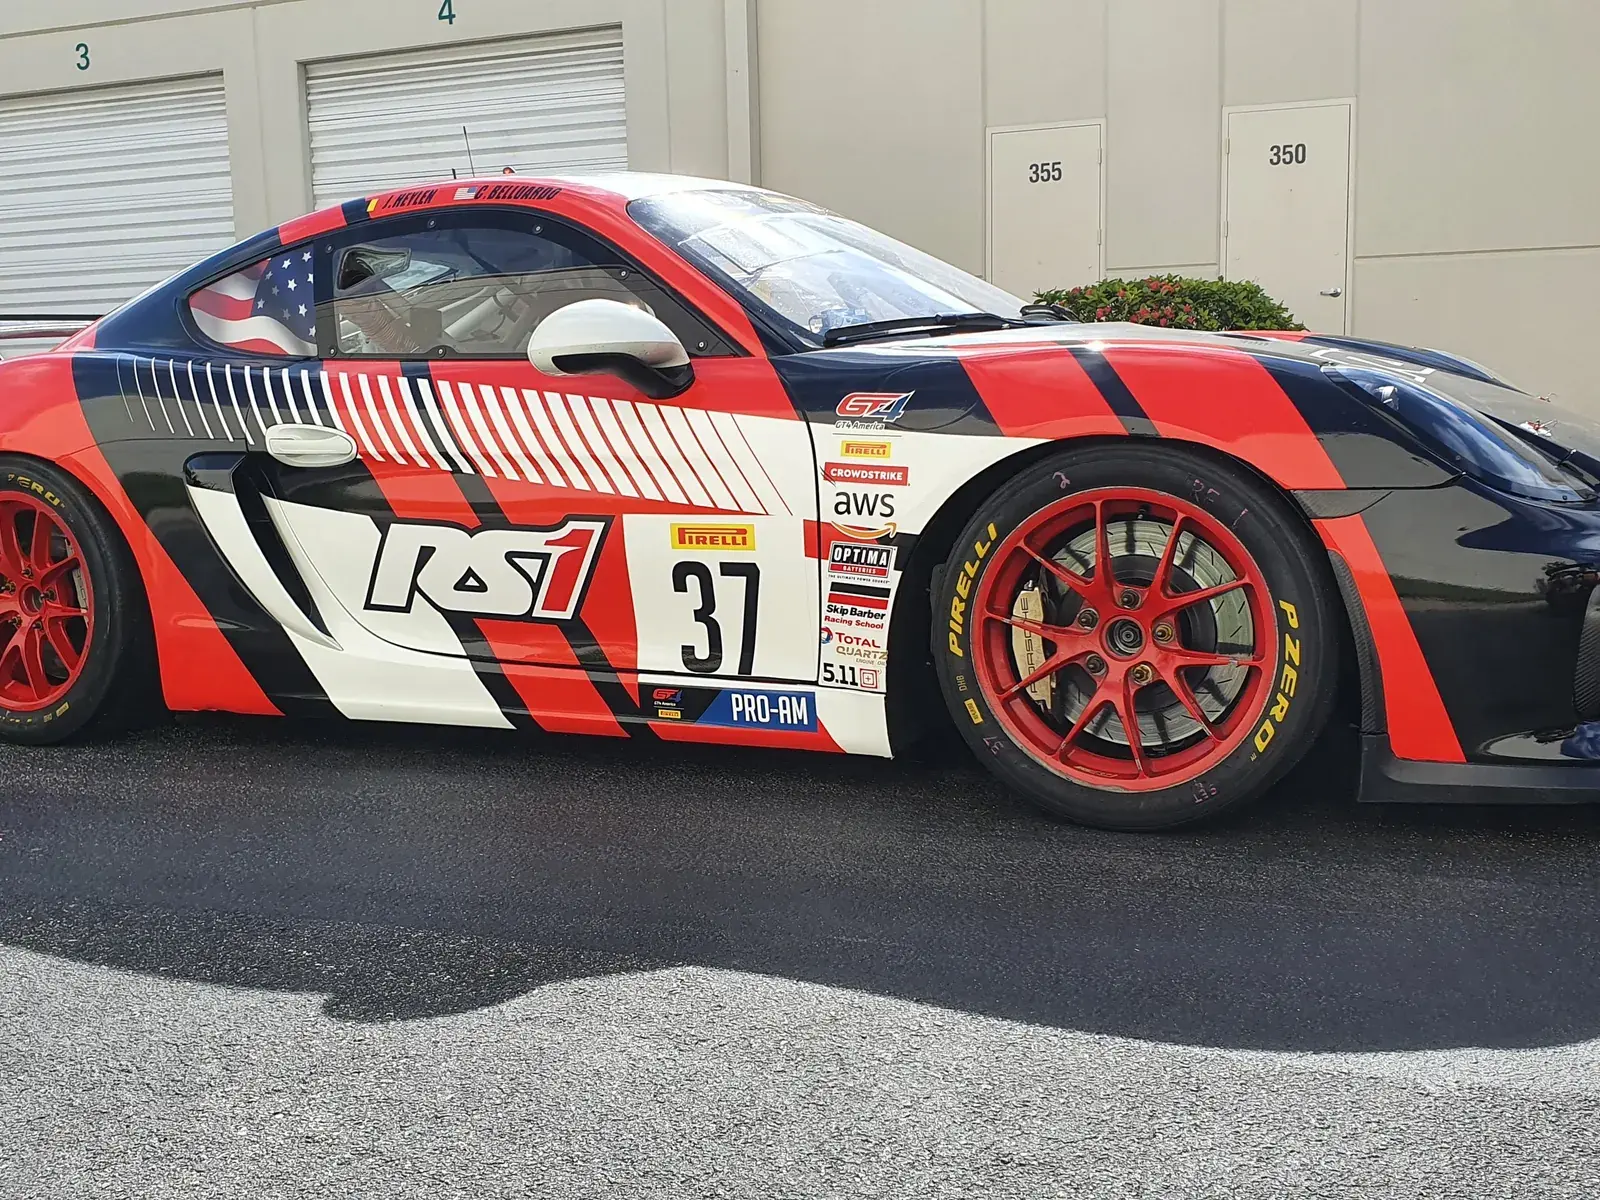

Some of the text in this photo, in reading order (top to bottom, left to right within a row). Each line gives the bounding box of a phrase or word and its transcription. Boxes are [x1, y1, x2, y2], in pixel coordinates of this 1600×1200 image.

[438, 0, 456, 25] 4
[75, 42, 91, 71] 3
[1269, 143, 1307, 167] 350
[1028, 161, 1063, 184] 355
[835, 421, 886, 430] GT4 America
[844, 442, 888, 456] PIRELLI
[830, 468, 903, 480] CROWDSTRIKE
[834, 491, 895, 518] aws
[677, 527, 748, 546] PIRELLI
[833, 546, 889, 567] OPTIMA
[842, 565, 877, 574] BATTERIES
[949, 522, 998, 657] PIRELLI
[672, 560, 761, 676] 37
[824, 615, 884, 630] Racing School
[826, 604, 887, 621] Skip Barber
[835, 632, 881, 649] TOTAL
[836, 645, 888, 660] QUARTZ
[823, 662, 859, 687] 5.11
[1254, 599, 1300, 753] P ZERO
[731, 693, 809, 726] PRO-AM
